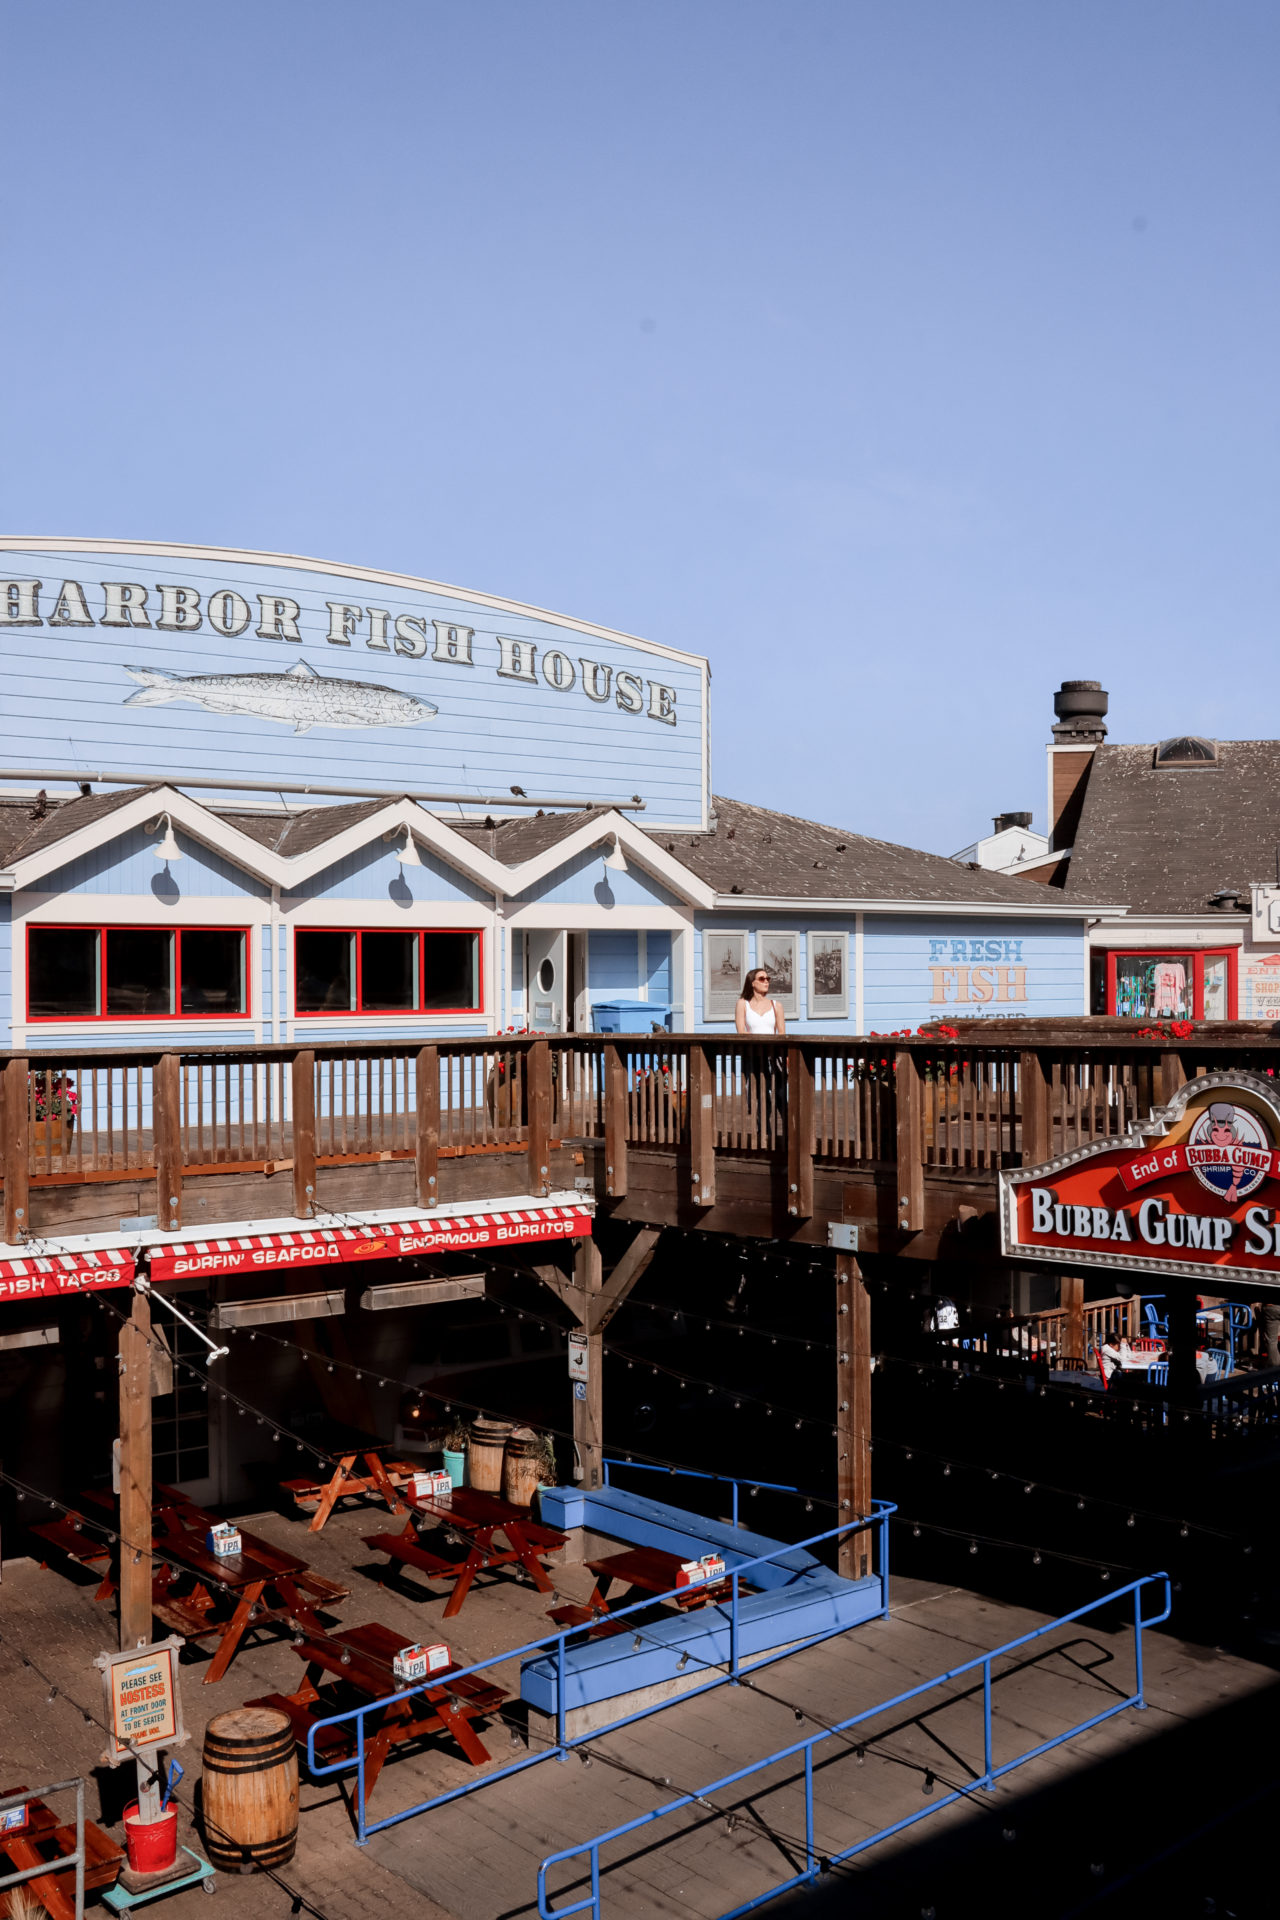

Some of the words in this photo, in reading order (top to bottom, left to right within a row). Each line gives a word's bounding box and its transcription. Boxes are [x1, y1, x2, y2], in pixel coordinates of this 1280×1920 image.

[0, 579, 303, 643] HARBOR
[325, 601, 475, 667] FISH
[496, 635, 677, 727] HOUSE
[928, 939, 1024, 962] FRESH
[928, 965, 1029, 1005] FISH
[1131, 1156, 1160, 1181] End
[1163, 1150, 1178, 1168] of
[1188, 1148, 1230, 1165] BUBBA
[1232, 1147, 1270, 1168] GUMP
[1030, 1187, 1133, 1242] BUBBA
[1138, 1198, 1233, 1252] GUMP
[174, 1253, 245, 1274] SURFIN'
[252, 1244, 340, 1265] SEAFOOD
[400, 1230, 490, 1253] ENORMOUS
[497, 1220, 575, 1240] BURRITOS
[0, 1276, 46, 1296] FISH
[57, 1267, 121, 1288] TACOS
[436, 1482, 450, 1492] IPA
[223, 1541, 239, 1553] IPA
[409, 1661, 425, 1676] IPA
[121, 1676, 146, 1691] PLEASE
[149, 1672, 162, 1683] SEE
[120, 1683, 165, 1707] HOSTESS
[120, 1710, 127, 1719] AT
[130, 1704, 148, 1716] FRONT
[151, 1699, 166, 1710] DOOR
[133, 1721, 141, 1729] BE
[143, 1714, 164, 1725] SEATED
